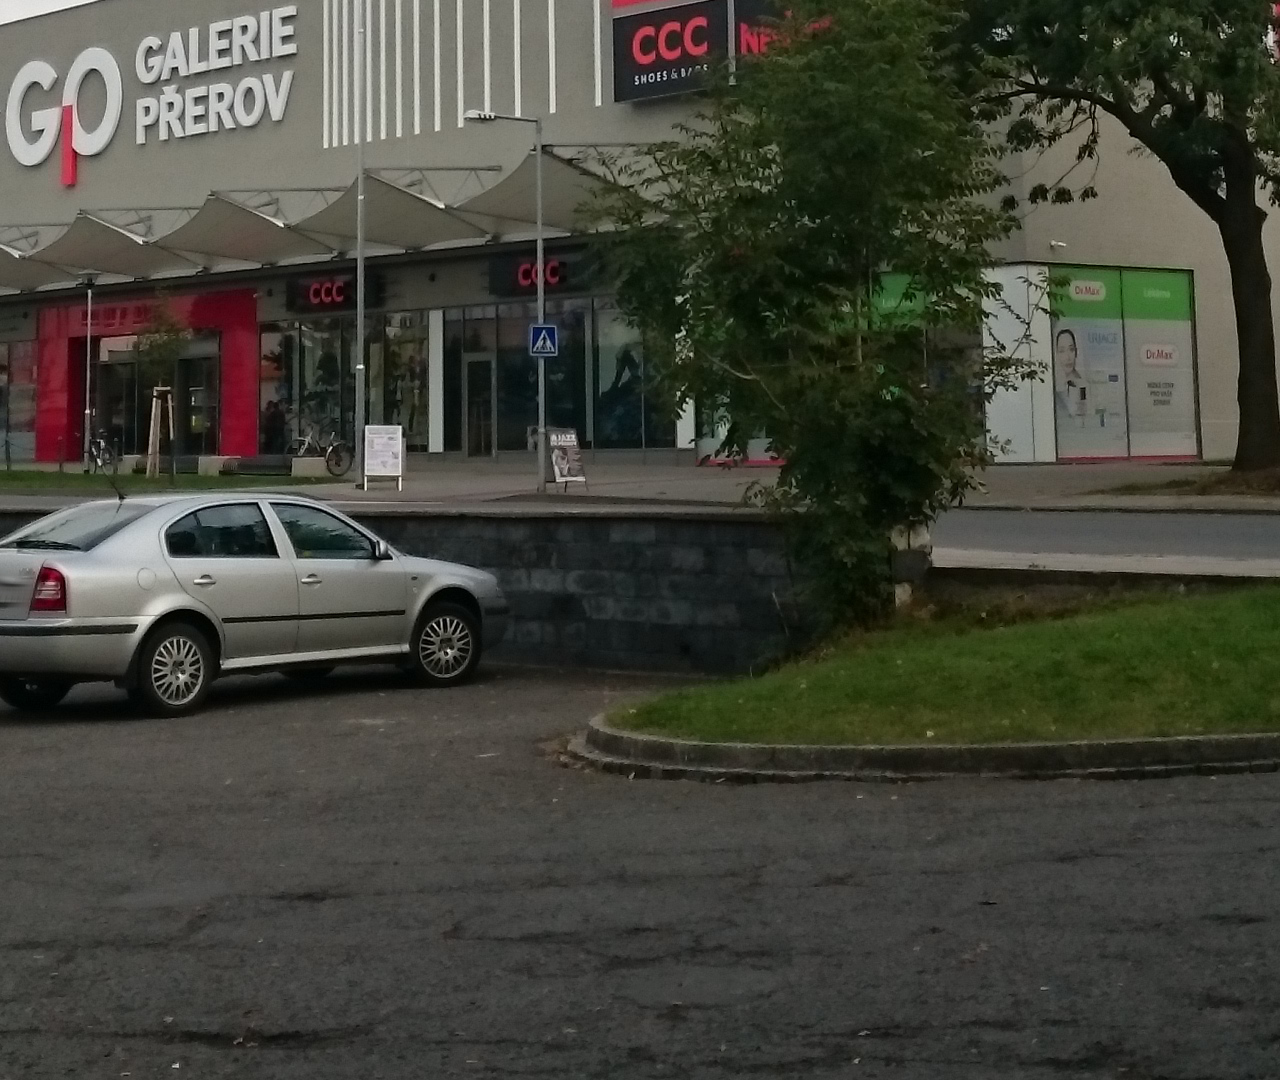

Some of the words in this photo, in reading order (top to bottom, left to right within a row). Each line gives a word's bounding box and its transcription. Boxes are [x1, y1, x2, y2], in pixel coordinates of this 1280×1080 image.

[135, 4, 298, 85] GALERIE
[632, 16, 708, 65] CCC
[634, 70, 668, 86] SHOES
[670, 68, 679, 80] &
[135, 70, 294, 146] PŘEROV
[309, 281, 344, 304] CCC
